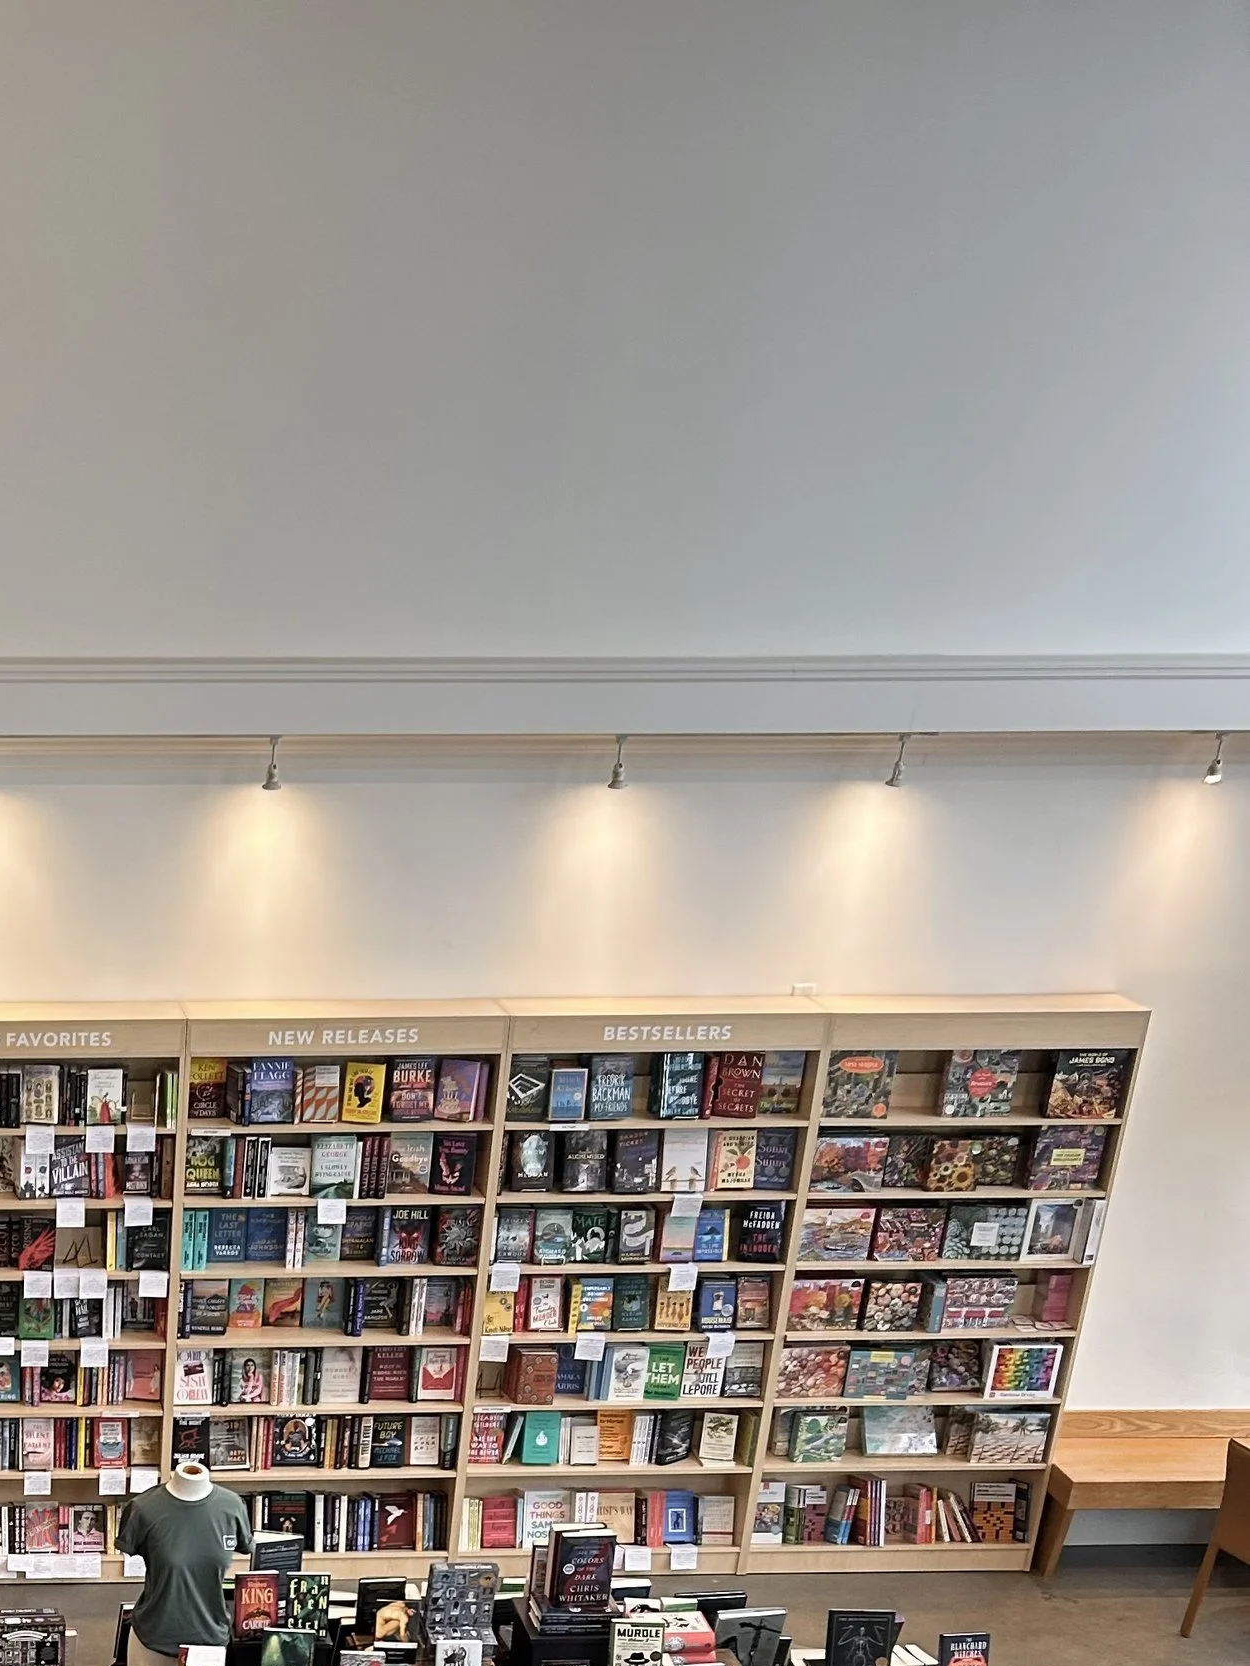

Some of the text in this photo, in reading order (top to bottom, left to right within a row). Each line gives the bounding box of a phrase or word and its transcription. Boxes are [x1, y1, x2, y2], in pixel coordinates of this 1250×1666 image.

[268, 1028, 419, 1046] NEW RELEASES
[603, 1025, 732, 1041] BESTSELLERS
[6, 1031, 112, 1048] FAVORITES
[723, 1054, 764, 1067] DAN
[253, 1062, 292, 1073] FANNIE
[721, 1067, 761, 1079] BROWN
[253, 1070, 290, 1081] FLAGG
[393, 1070, 432, 1084] BURKE
[597, 1074, 625, 1087] FREDRIK
[592, 1087, 631, 1102] BACKMAN
[722, 1088, 756, 1098] SECRET
[718, 1102, 754, 1113] SECRETS
[392, 1153, 429, 1165] Goodbye
[52, 1162, 89, 1185] VILLAIN
[186, 1168, 221, 1182] QUEEN
[221, 1213, 237, 1221] THE
[393, 1209, 429, 1221] JOE HILL
[750, 1209, 775, 1221] FREIDA
[219, 1222, 239, 1230] LAST
[743, 1219, 780, 1229] McFADDEN
[390, 1249, 426, 1263] SORROW
[689, 1346, 704, 1358] WE
[652, 1362, 675, 1373] LET
[687, 1358, 722, 1370] PEOPLE
[646, 1372, 680, 1385] THEM
[683, 1384, 719, 1396] LEPORE
[374, 1421, 403, 1431] FUTURE
[379, 1430, 397, 1439] BOY
[533, 1501, 563, 1510] GOOD
[530, 1511, 565, 1519] THINGS
[572, 1557, 605, 1565] COLORS
[241, 1588, 274, 1605] KING
[558, 1593, 608, 1602] WHITAKER
[242, 1618, 271, 1630] CARRIE
[617, 1628, 661, 1638] MURDLE
[950, 1642, 987, 1651] BLANCHARD
